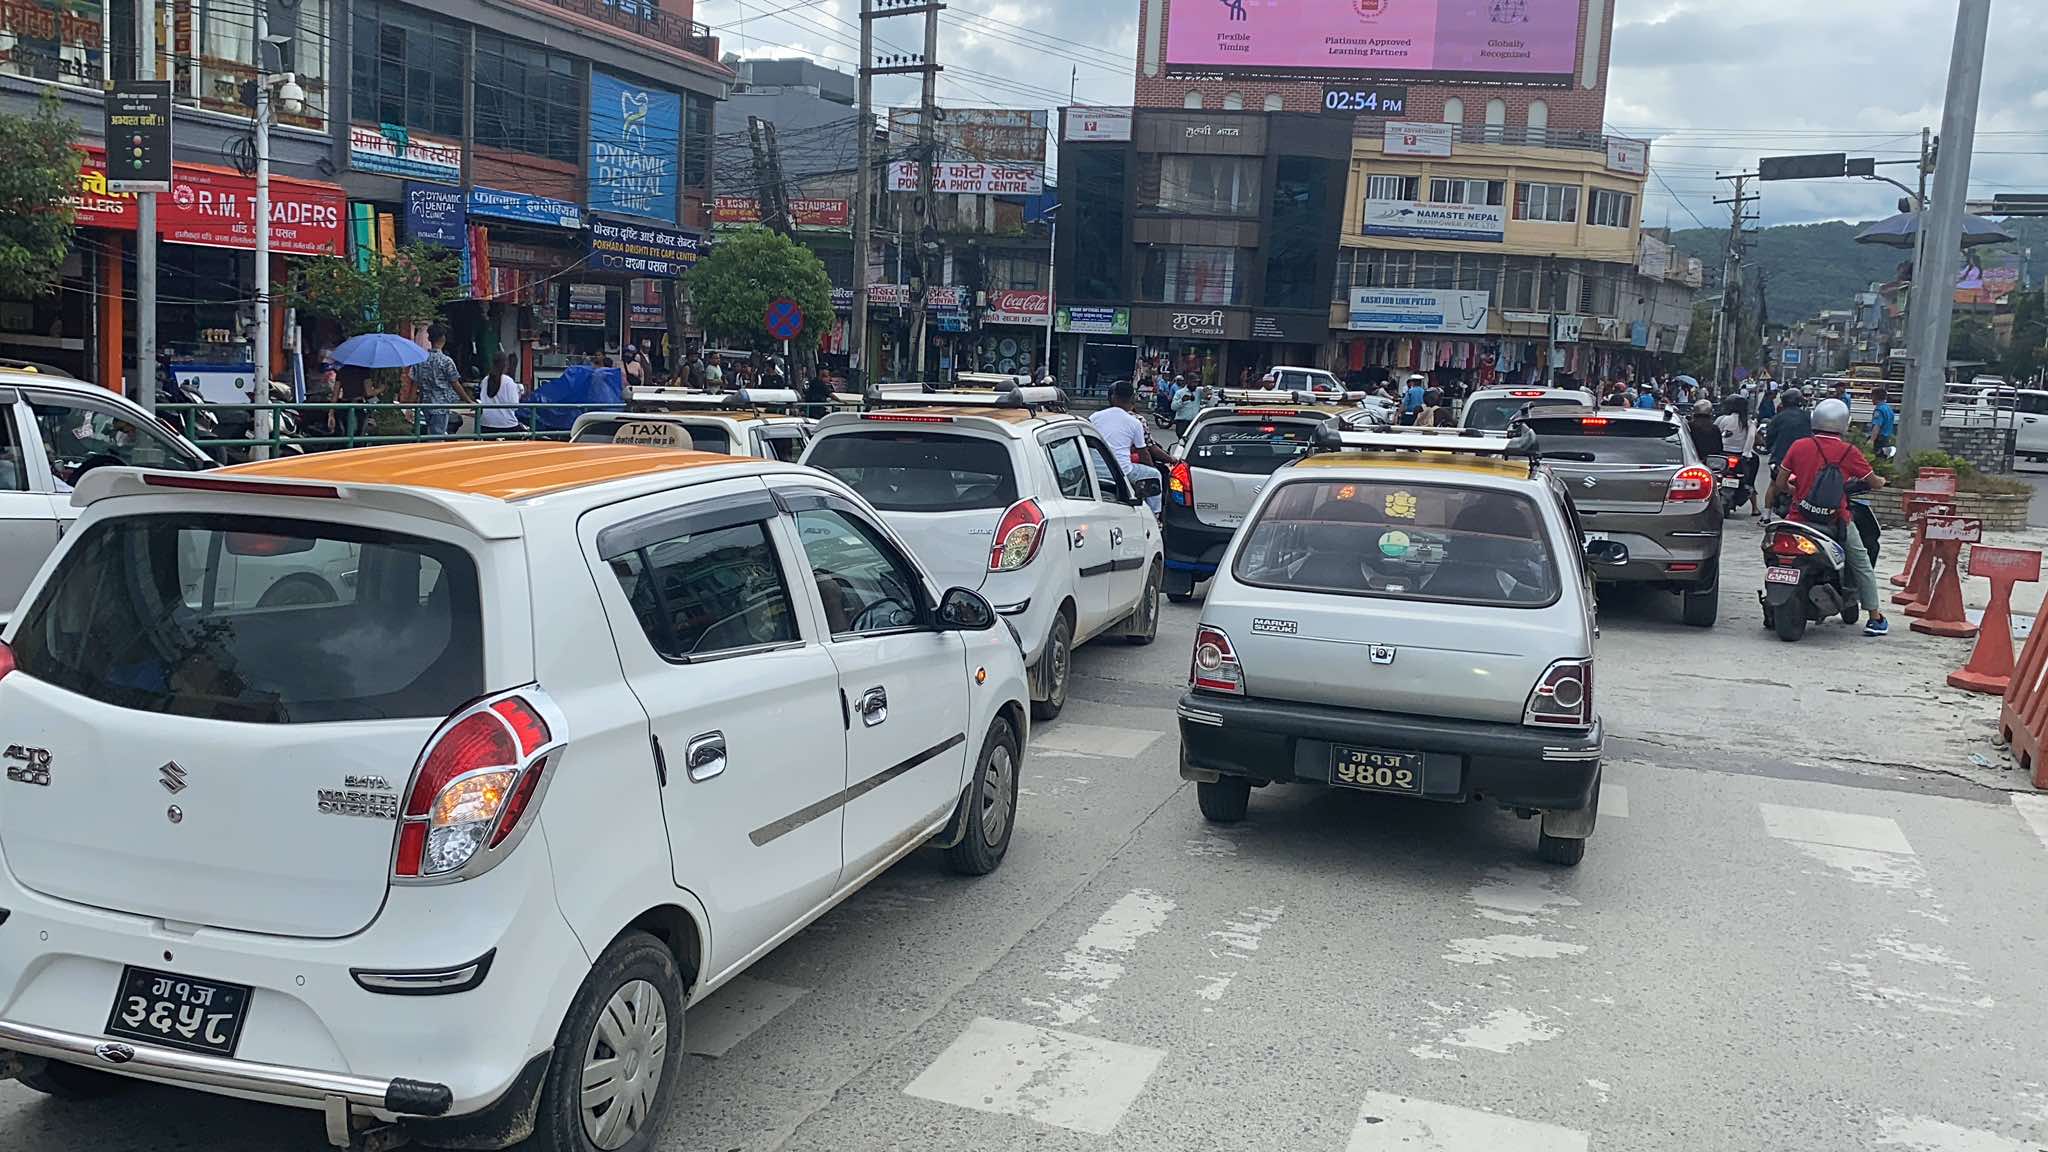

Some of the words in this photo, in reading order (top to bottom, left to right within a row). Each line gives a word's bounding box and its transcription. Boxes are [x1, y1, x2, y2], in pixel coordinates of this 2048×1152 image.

[1217, 33, 1250, 41] Flexible
[1325, 37, 1367, 46] Platinum
[1369, 38, 1411, 48] Approved
[1488, 40, 1525, 49] Globally
[1219, 43, 1250, 52] Timing
[1329, 47, 1368, 57] Learning
[1370, 48, 1408, 57] Partners
[1480, 50, 1530, 59] Recognized
[1326, 91, 1377, 111] 02:54
[1383, 99, 1402, 111] PM
[596, 142, 667, 175] DYNAMIC
[950, 164, 986, 179] फोटो
[992, 165, 1036, 181] सेन्टर
[599, 166, 664, 196] DENTAL
[898, 178, 946, 190] POKRA
[950, 179, 981, 190] PHOTO
[988, 181, 1027, 193] CENTRE
[199, 190, 241, 219] R.M.
[426, 191, 461, 203] DYNAMIC
[612, 190, 651, 211] CLINIC
[426, 202, 456, 213] DENTAL
[788, 200, 843, 211] RESTAURANT
[426, 211, 445, 220] CLINIC
[1417, 210, 1465, 220] NAMASTE
[1468, 213, 1499, 222] NEPAL
[594, 222, 619, 237] पोखरा
[620, 227, 638, 241] दृष्टि
[640, 231, 655, 244] आई
[656, 232, 674, 246] केयर
[676, 234, 697, 249] सेन्टर
[592, 239, 624, 252] POKHARA
[625, 243, 649, 255] DRISHTI
[649, 247, 660, 257] EYE
[660, 249, 675, 260] CARE
[676, 251, 697, 262] CENTER
[625, 257, 646, 271] चश्मा
[648, 260, 668, 273] पसल
[1360, 296, 1380, 304] KASKI
[1382, 296, 1394, 305] JOB
[1396, 296, 1410, 305] LINK
[1172, 310, 1225, 331] मुल्मी
[630, 424, 667, 436] TAXI
[1254, 619, 1297, 628] MARUTI
[1254, 625, 1297, 633] SUZUKI
[3, 744, 52, 764] ALTO
[1352, 751, 1402, 767] ग१ज
[1338, 762, 1413, 788] ५४०२
[317, 787, 398, 805] MARUTI
[317, 800, 398, 821] SUZUKI
[152, 977, 217, 1007] ग१ज
[122, 995, 233, 1044] ३६५८
